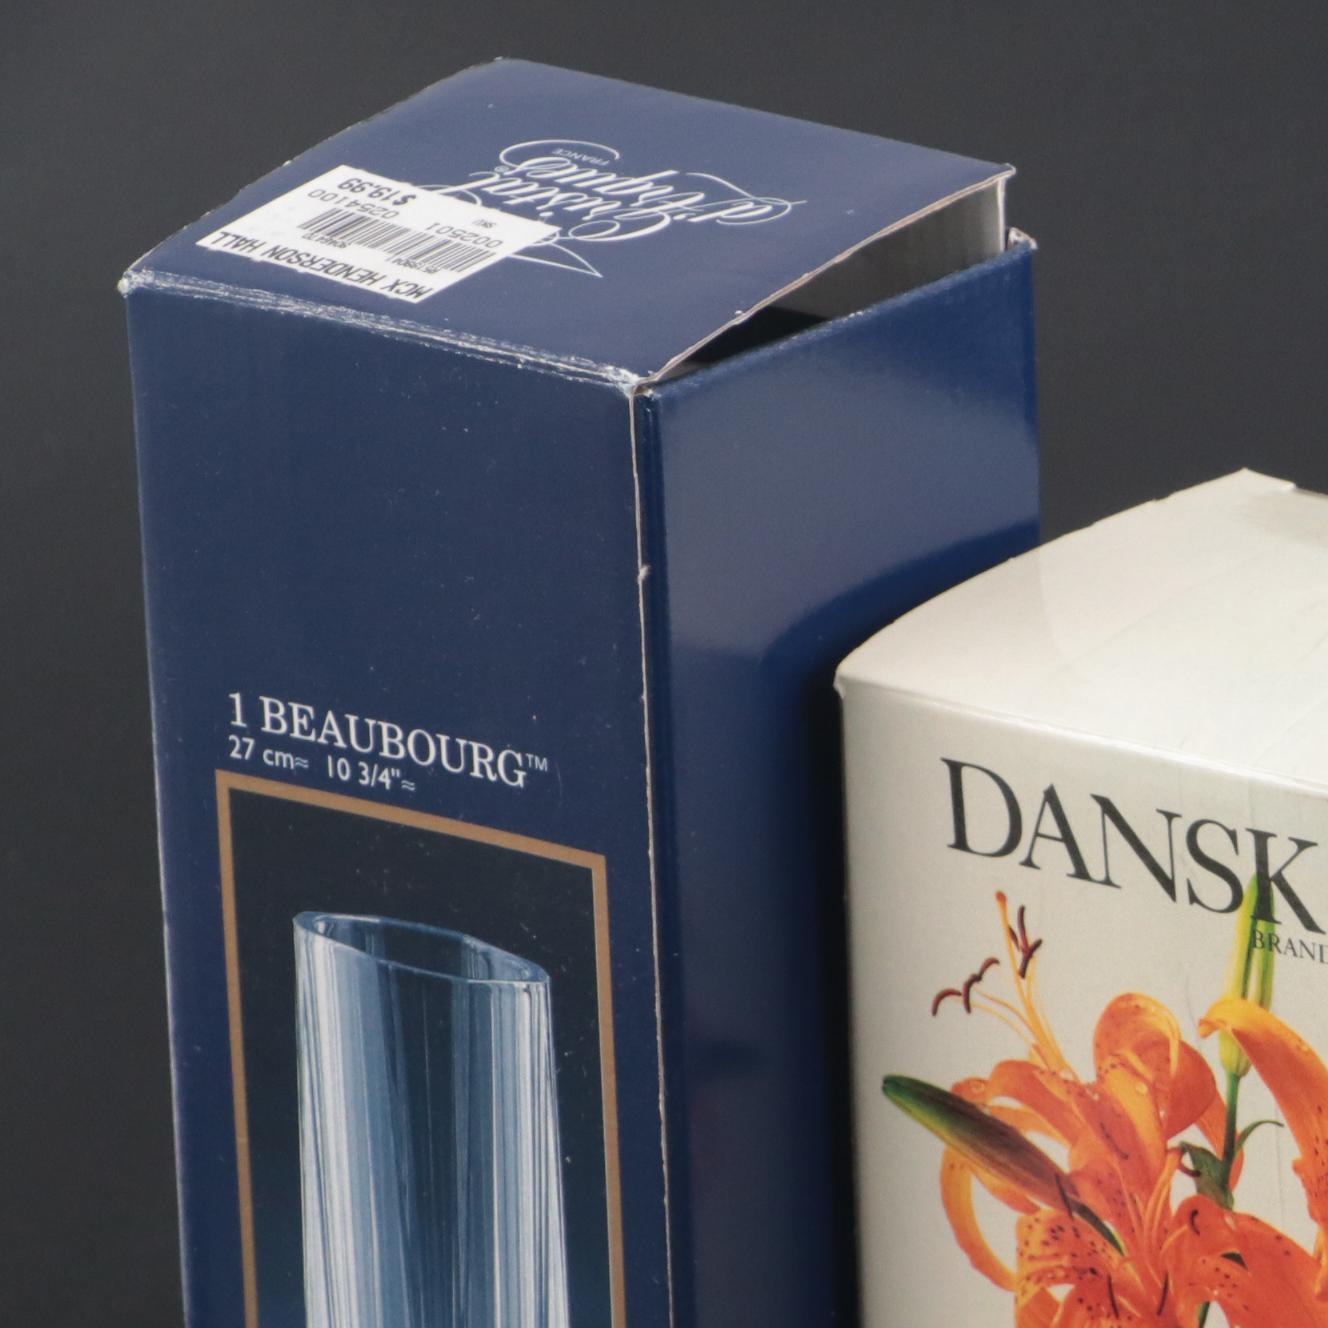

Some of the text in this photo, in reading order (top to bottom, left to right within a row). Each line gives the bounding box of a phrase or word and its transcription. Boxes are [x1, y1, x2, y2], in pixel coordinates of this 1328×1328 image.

[552, 148, 609, 167] FRANCE
[337, 176, 417, 207] $19.99
[307, 187, 504, 248] 002501 0254100
[210, 230, 434, 300] MCX HENDERSON HALL
[228, 691, 248, 729] 1
[228, 734, 256, 761] 27
[326, 756, 351, 782] 10
[940, 756, 1327, 936] DANSK
